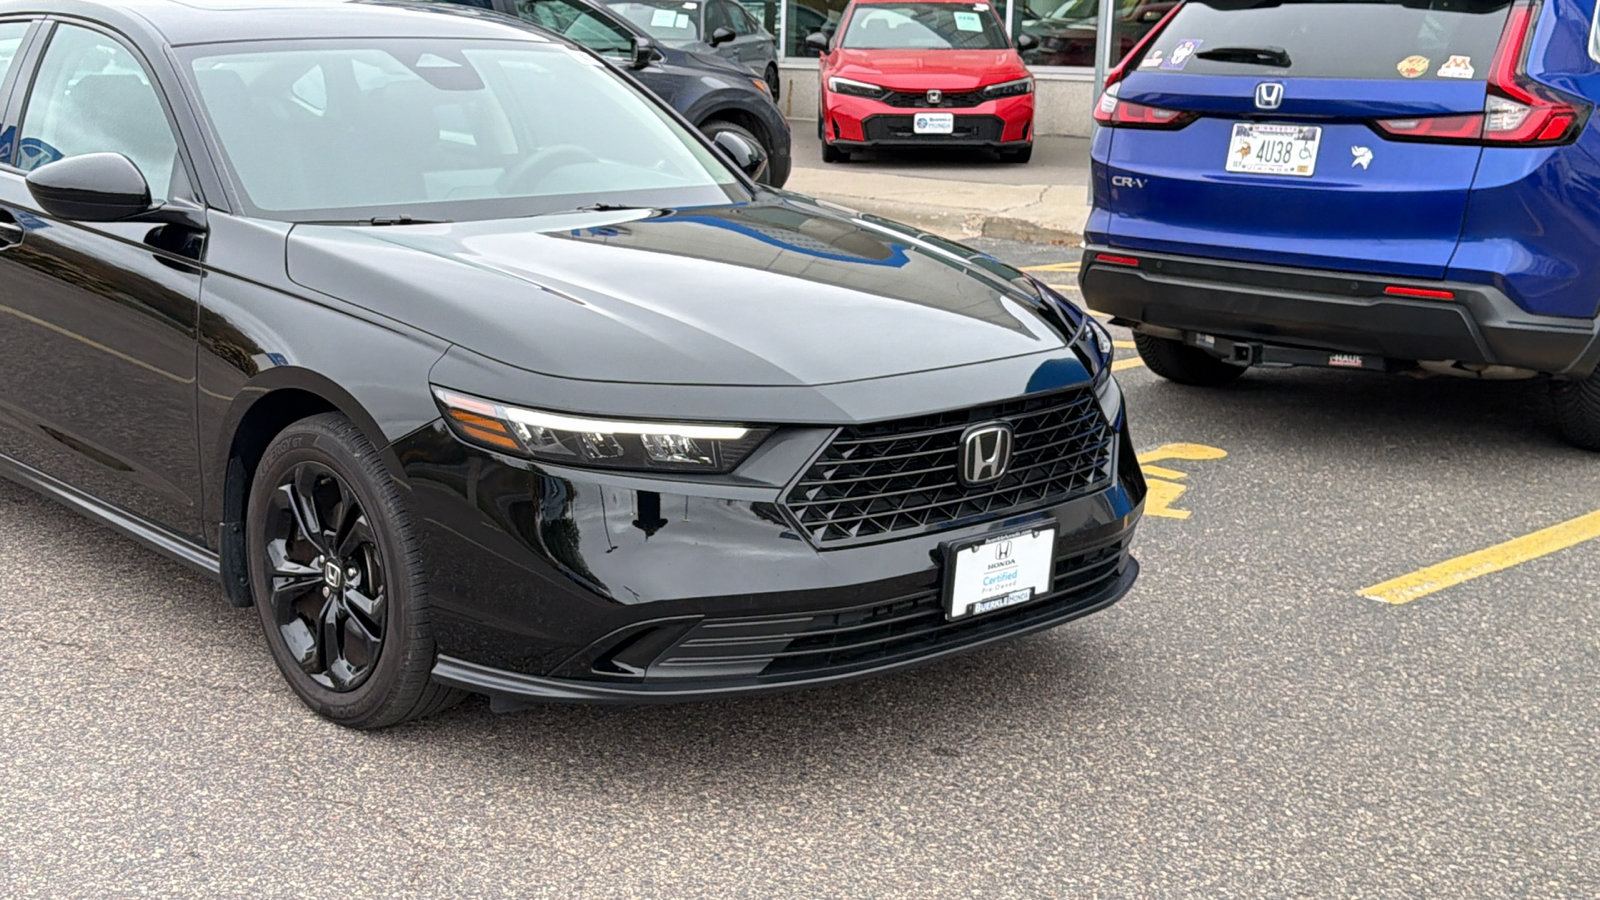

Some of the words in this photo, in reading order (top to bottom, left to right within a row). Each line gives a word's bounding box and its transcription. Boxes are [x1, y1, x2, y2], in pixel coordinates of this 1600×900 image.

[1256, 139, 1293, 164] 4U38
[1111, 175, 1148, 188] CR-V
[987, 559, 1016, 570] HONDA
[983, 569, 1018, 586] Certified
